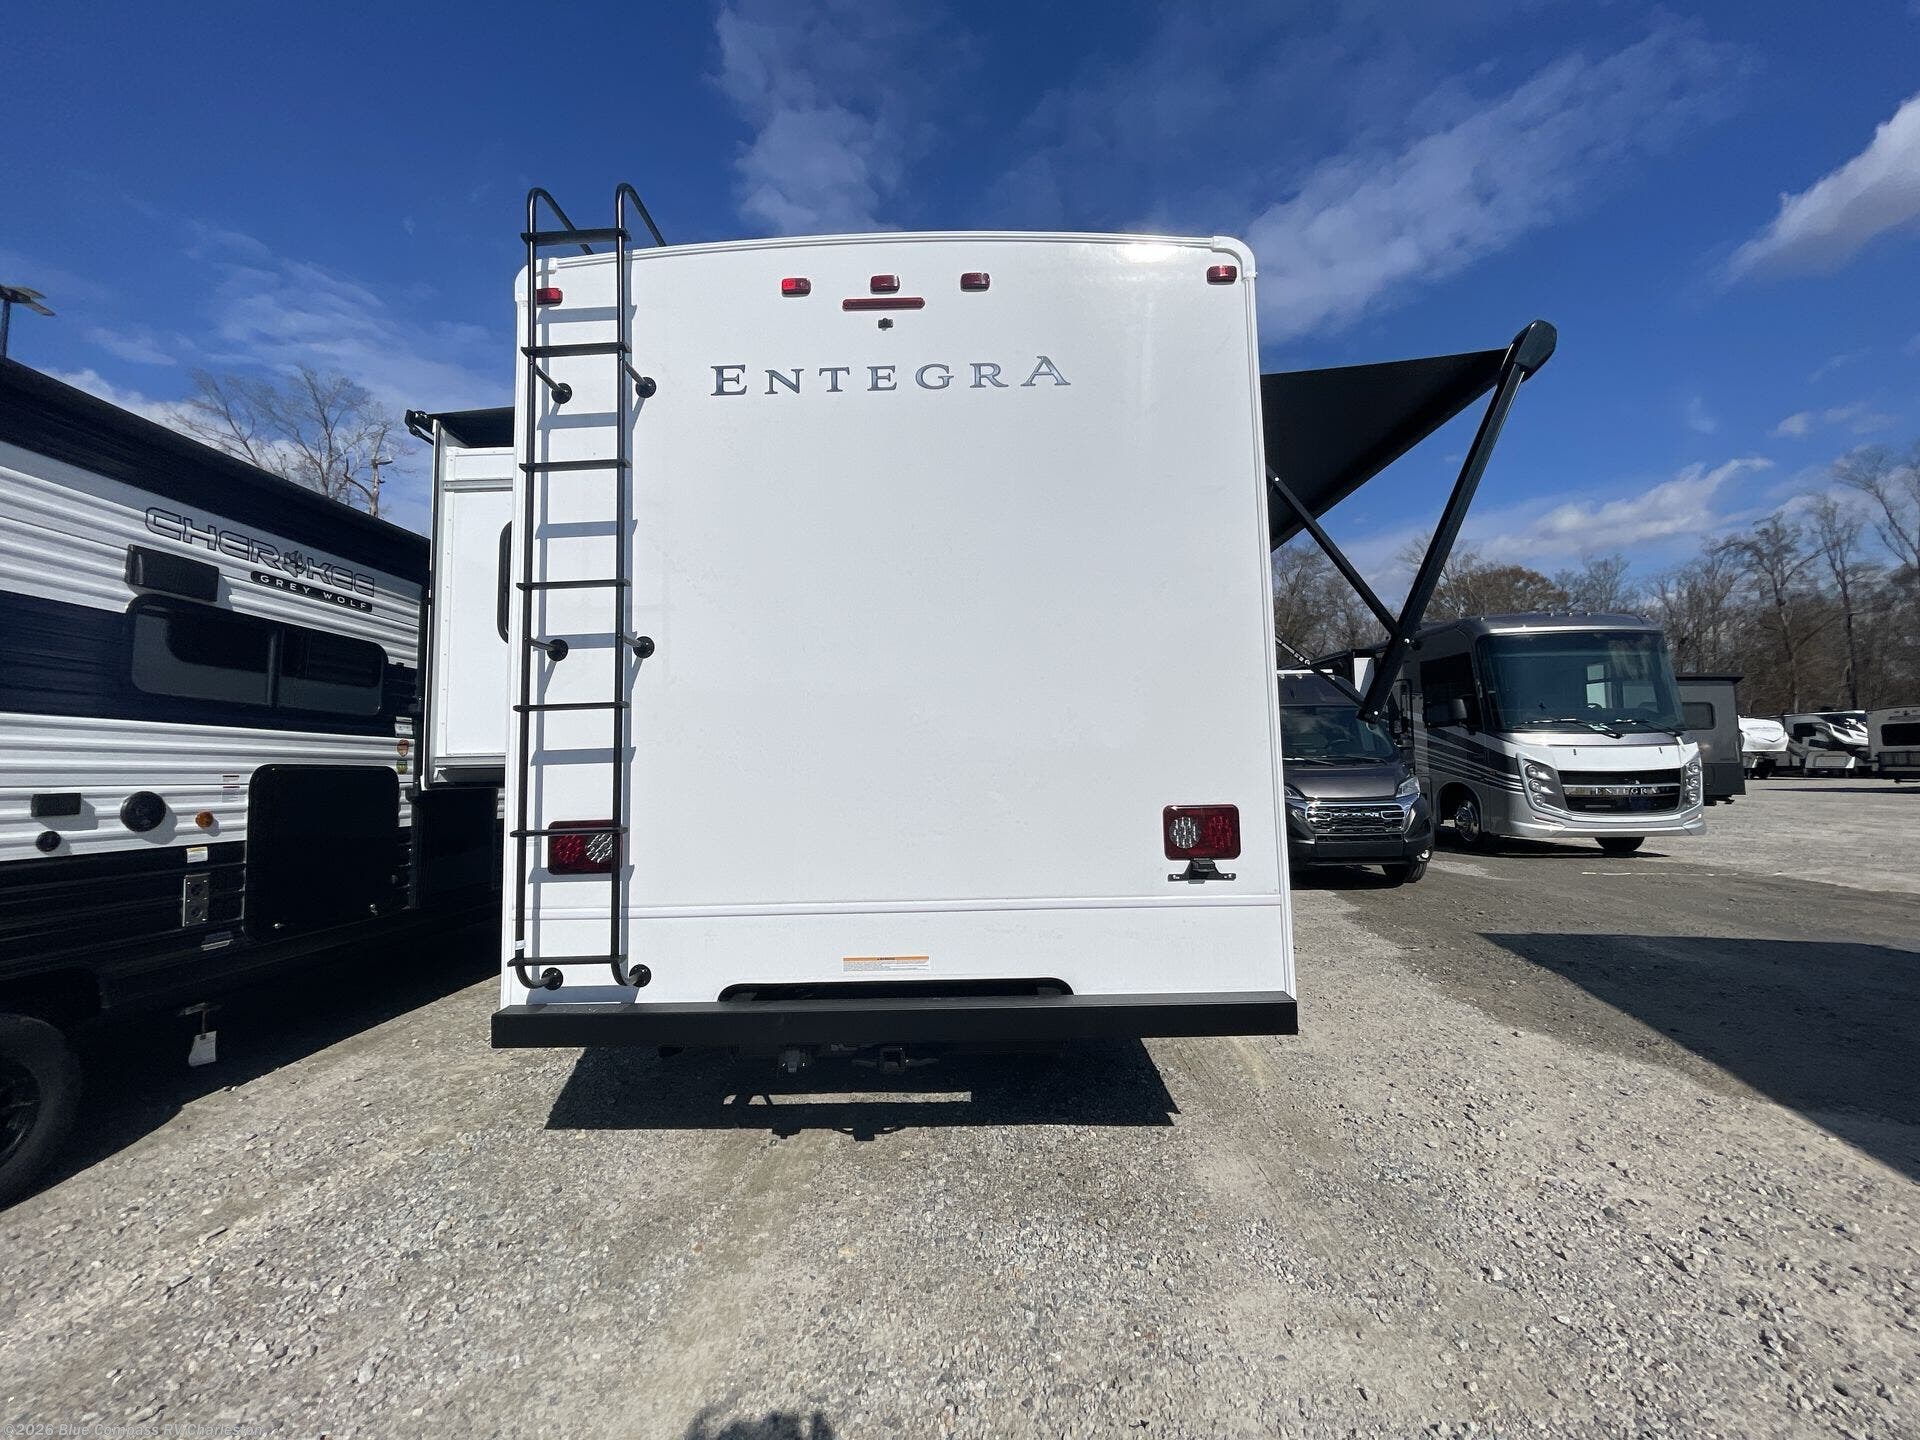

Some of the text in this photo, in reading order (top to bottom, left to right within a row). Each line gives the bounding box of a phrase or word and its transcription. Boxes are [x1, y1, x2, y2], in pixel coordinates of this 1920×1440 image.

[710, 355, 1072, 397] ENTEGRA
[260, 575, 367, 609] GREY WOLF
